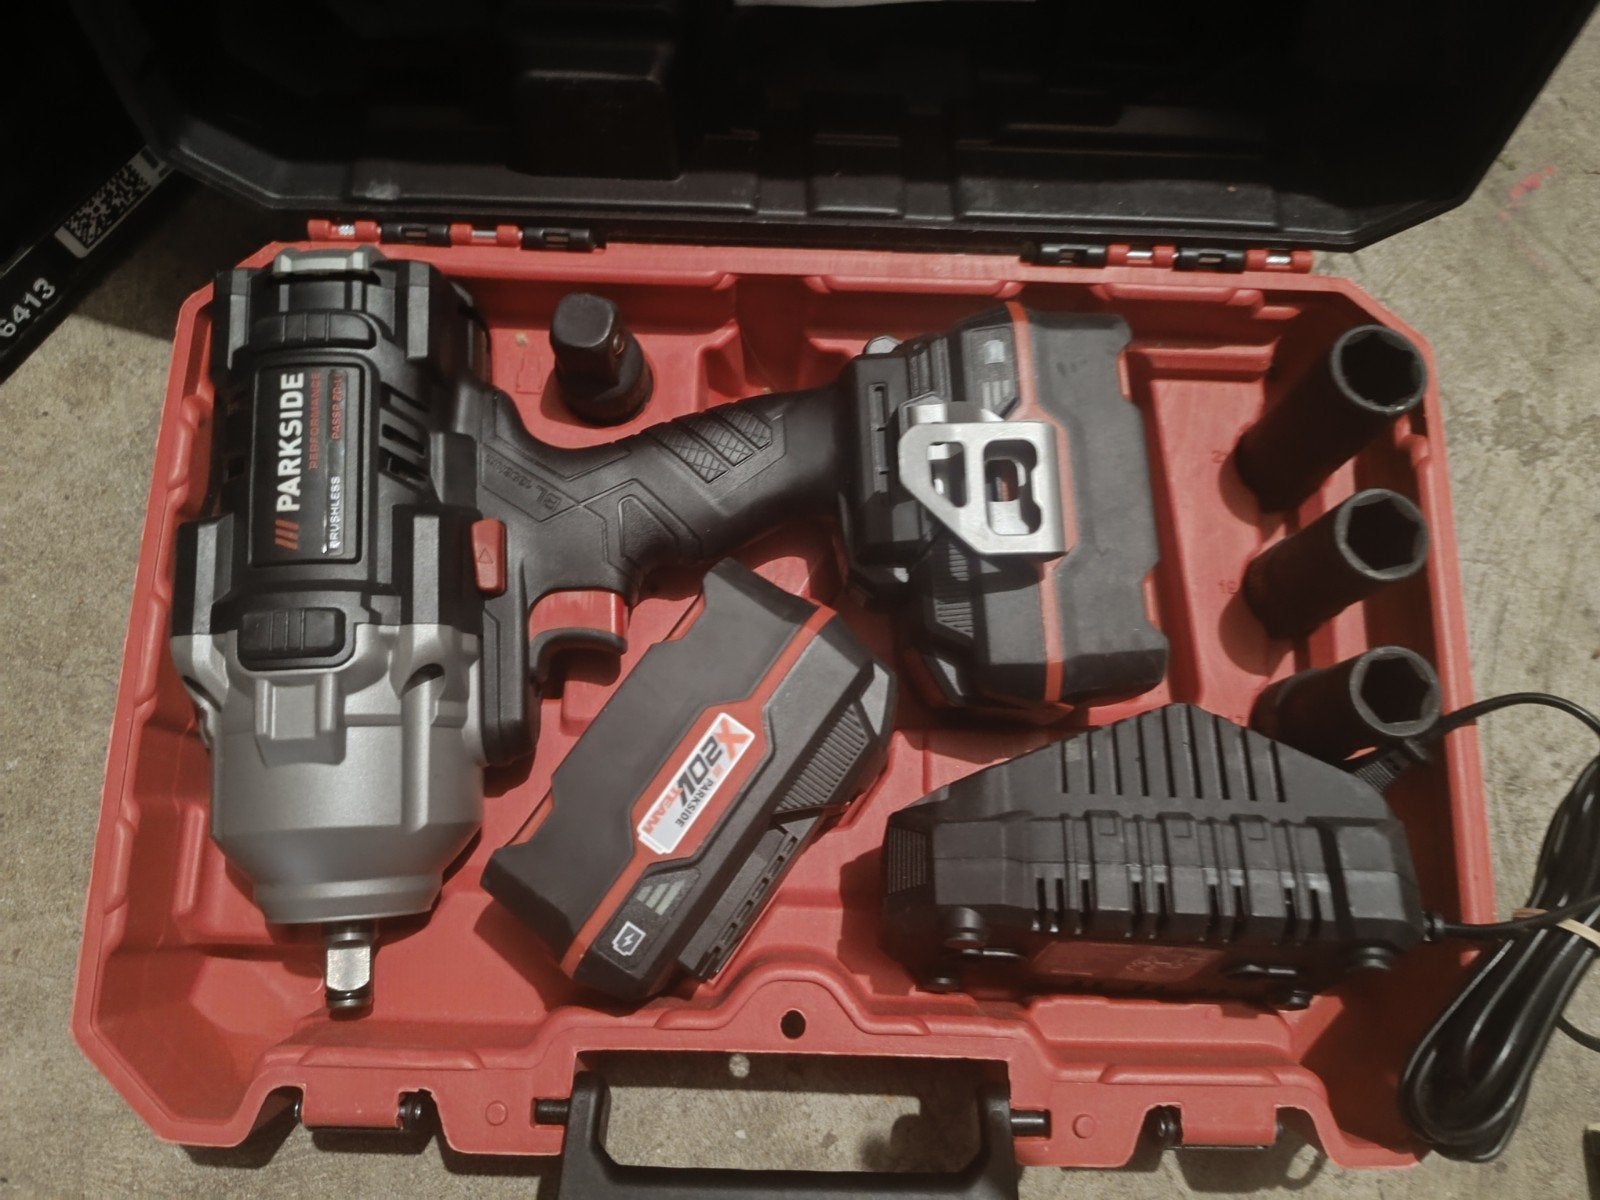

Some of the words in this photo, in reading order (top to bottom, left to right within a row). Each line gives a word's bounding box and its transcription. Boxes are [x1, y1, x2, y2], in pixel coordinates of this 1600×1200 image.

[0, 278, 56, 337] 6413
[276, 372, 304, 512] PARKSIDE
[308, 373, 321, 470] PERFORMANCE
[331, 403, 342, 439] PASSP
[330, 476, 341, 549] BRUSHLESS
[641, 786, 684, 835] TEAM
[675, 778, 714, 827] PARKSIDE
